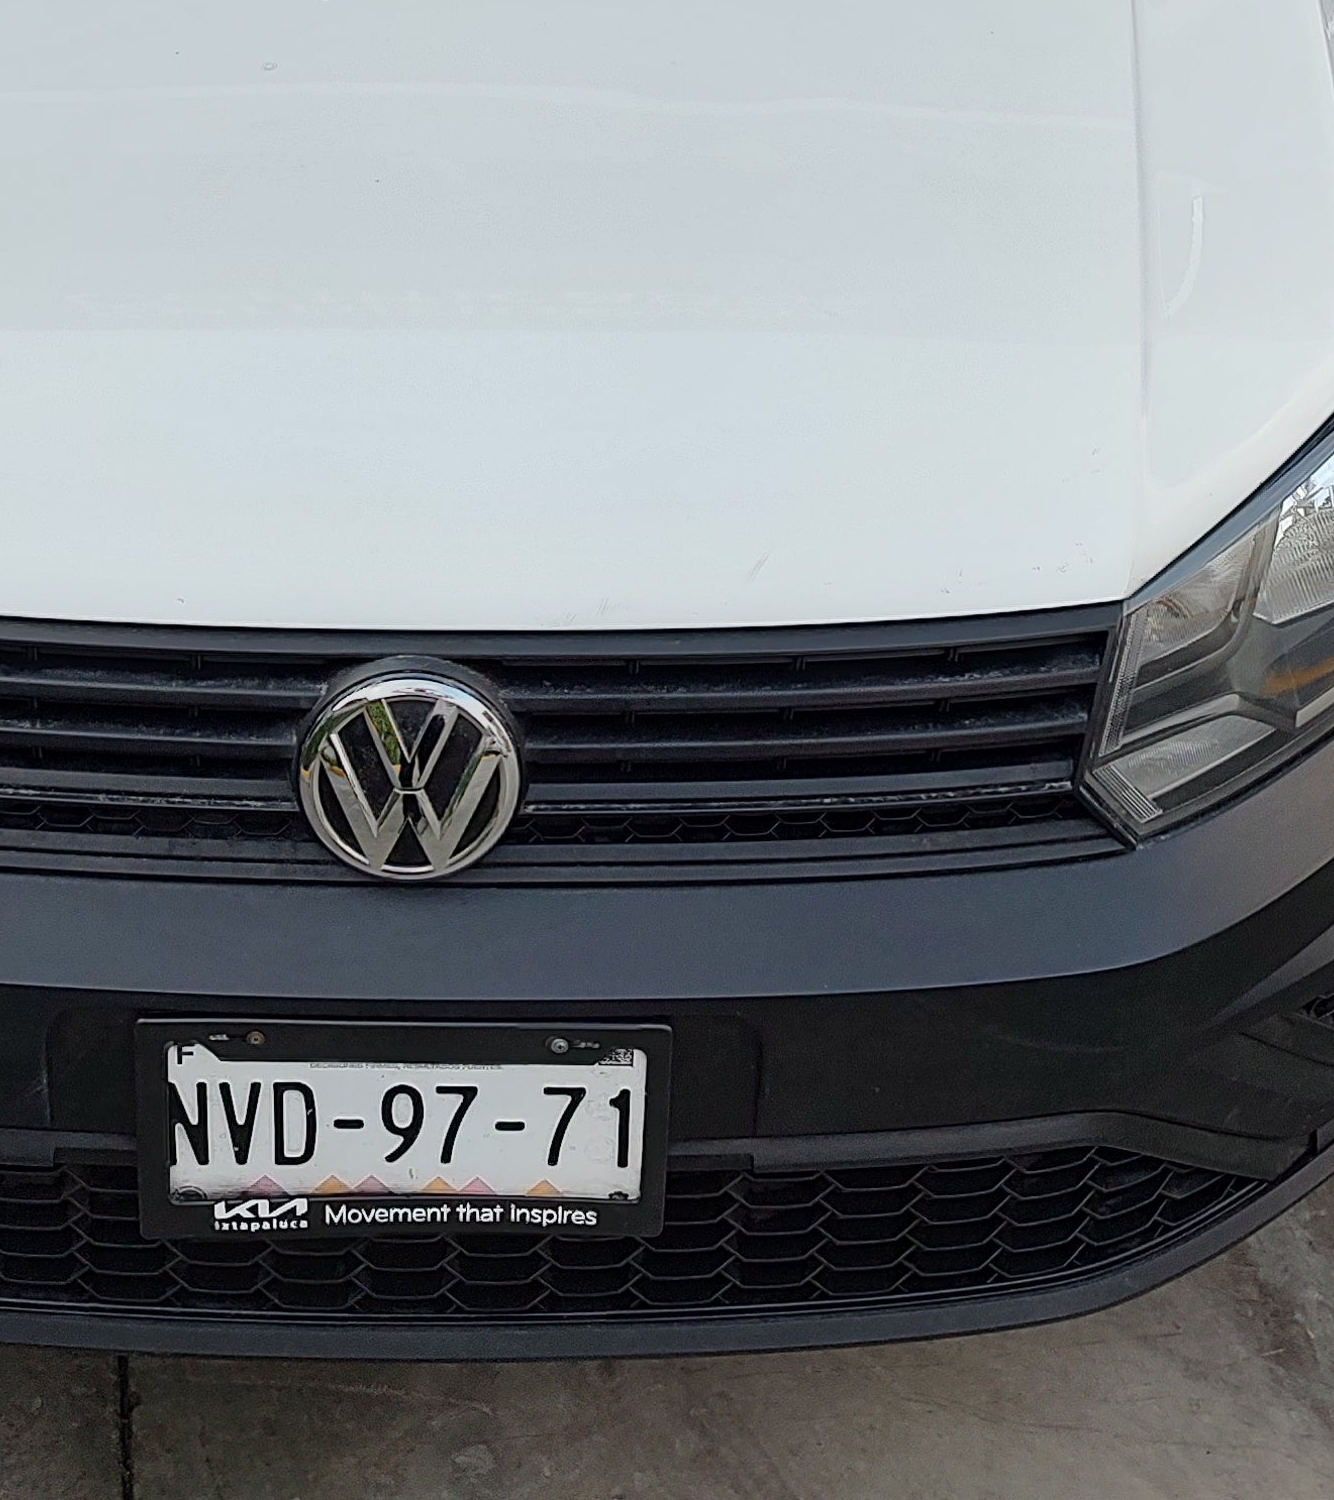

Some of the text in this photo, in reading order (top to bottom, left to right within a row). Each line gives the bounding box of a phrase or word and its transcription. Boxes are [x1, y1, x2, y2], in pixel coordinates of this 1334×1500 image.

[169, 1080, 631, 1169] NVD-97-71
[325, 1202, 598, 1228] Movement that inspires
